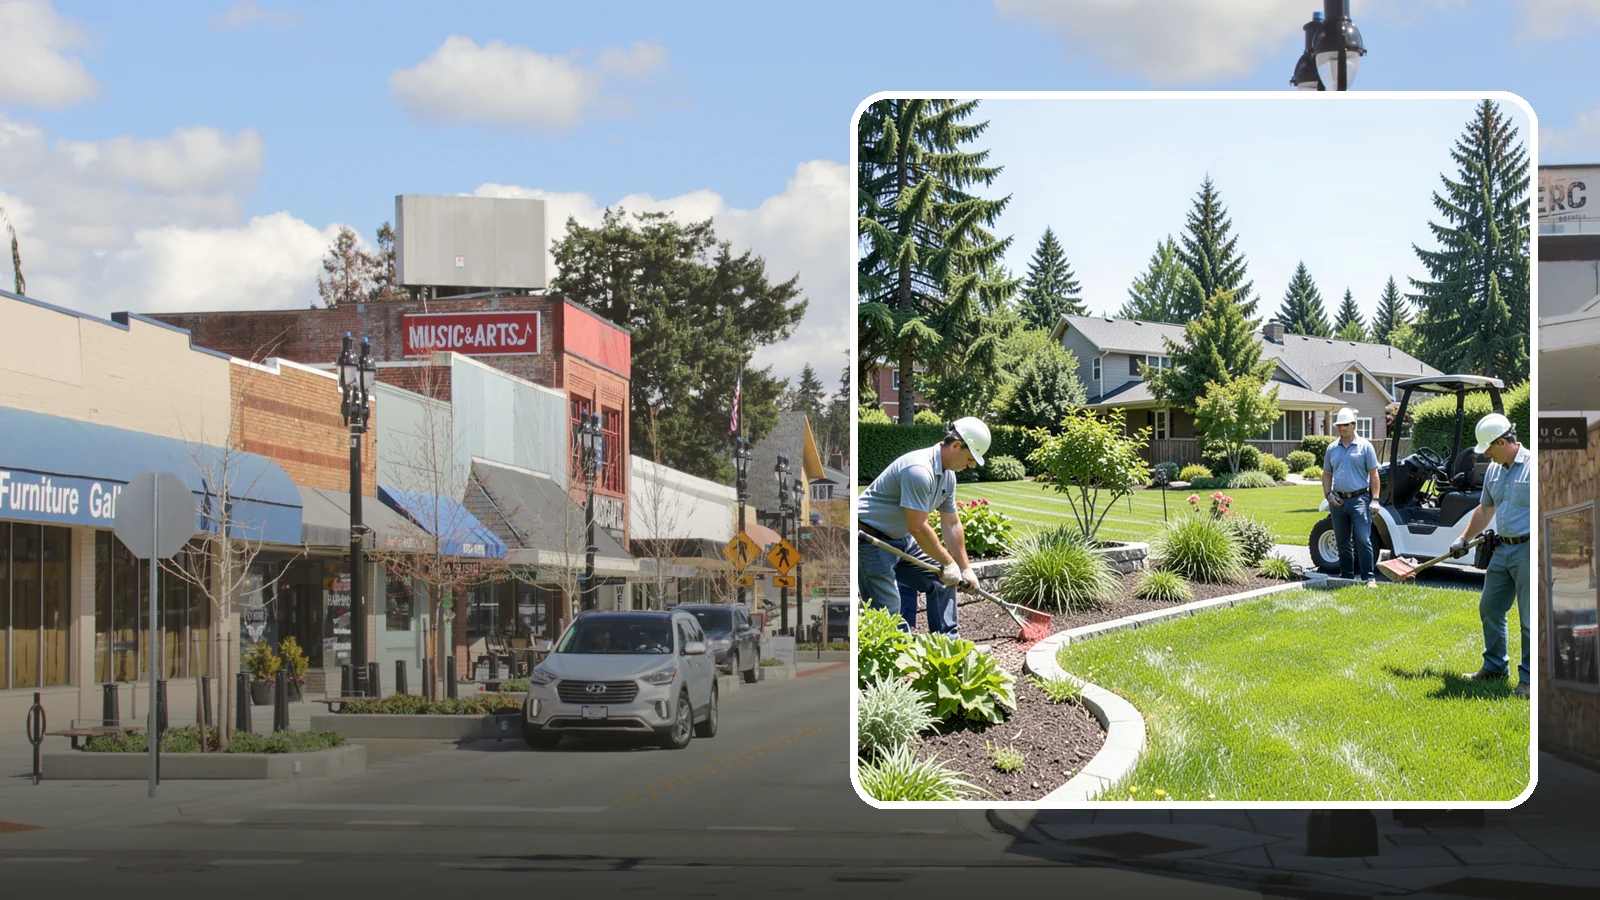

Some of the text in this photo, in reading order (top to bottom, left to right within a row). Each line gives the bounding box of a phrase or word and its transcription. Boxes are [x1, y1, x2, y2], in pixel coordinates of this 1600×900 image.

[0, 472, 121, 519] Furniture Gal
[453, 563, 479, 574] SUSHI
